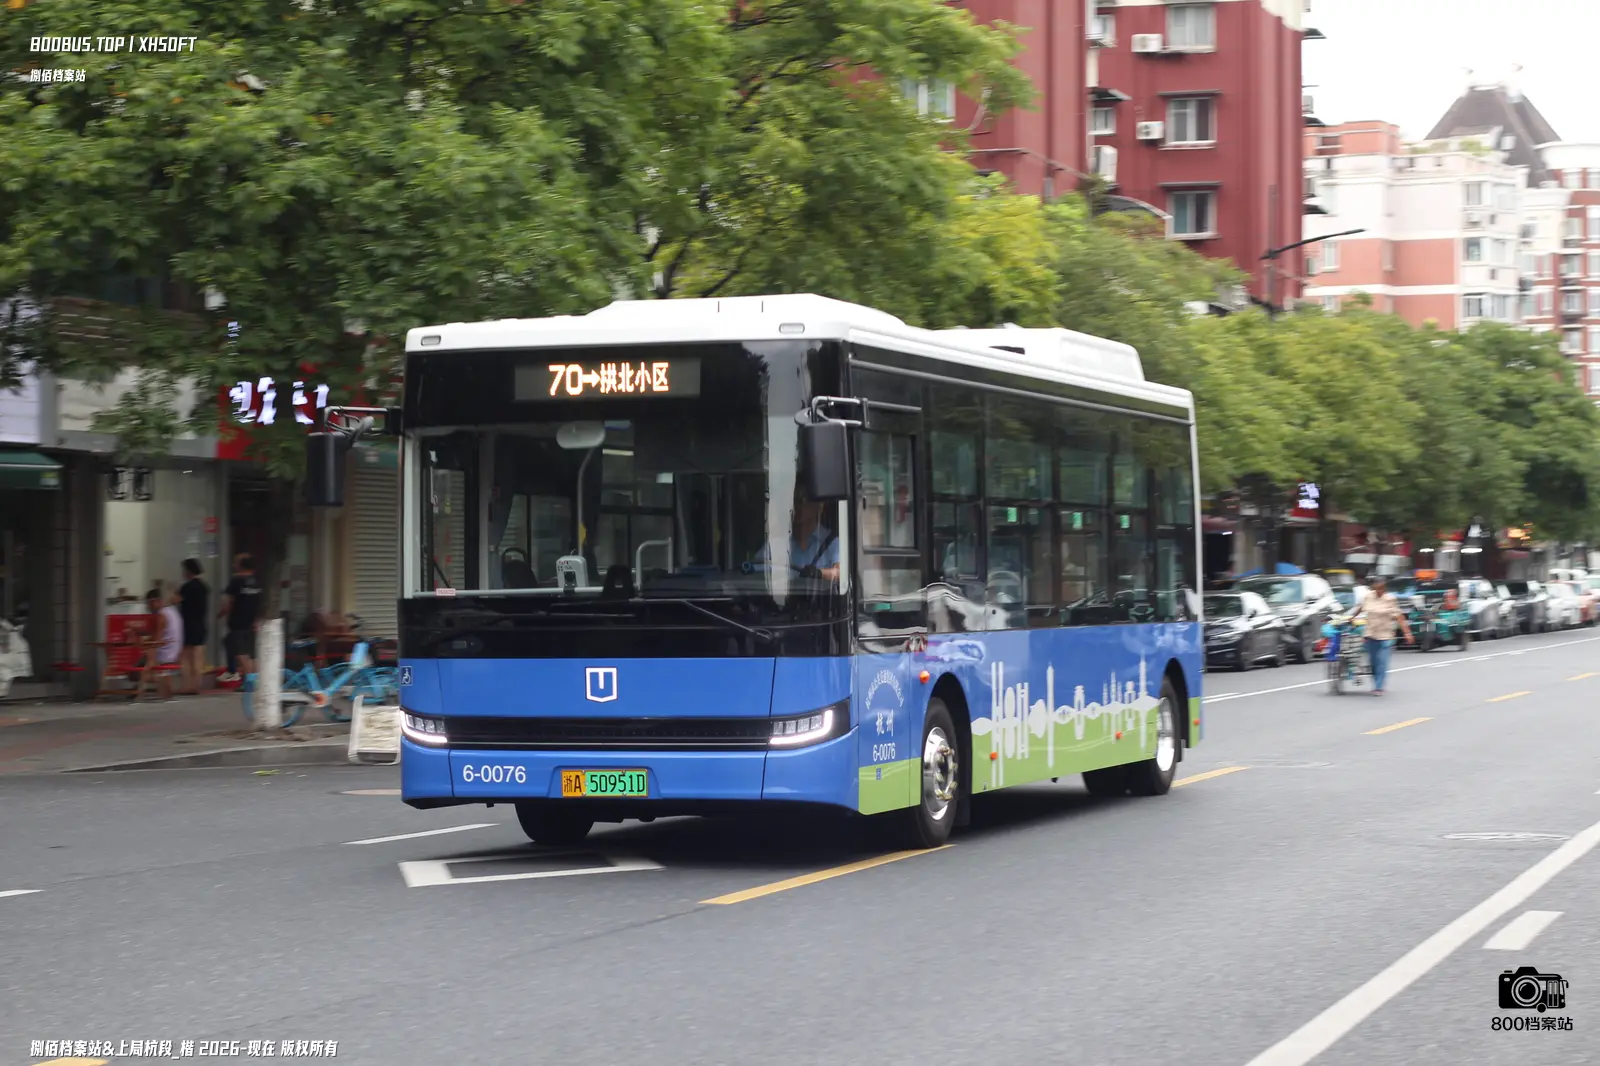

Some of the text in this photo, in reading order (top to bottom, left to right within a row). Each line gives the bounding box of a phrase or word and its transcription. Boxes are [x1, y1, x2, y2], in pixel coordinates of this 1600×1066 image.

[600, 362, 669, 394] 拱北小区
[872, 742, 896, 762] 6-0076
[462, 764, 527, 784] 6-0076
[590, 773, 645, 793] 50951D
